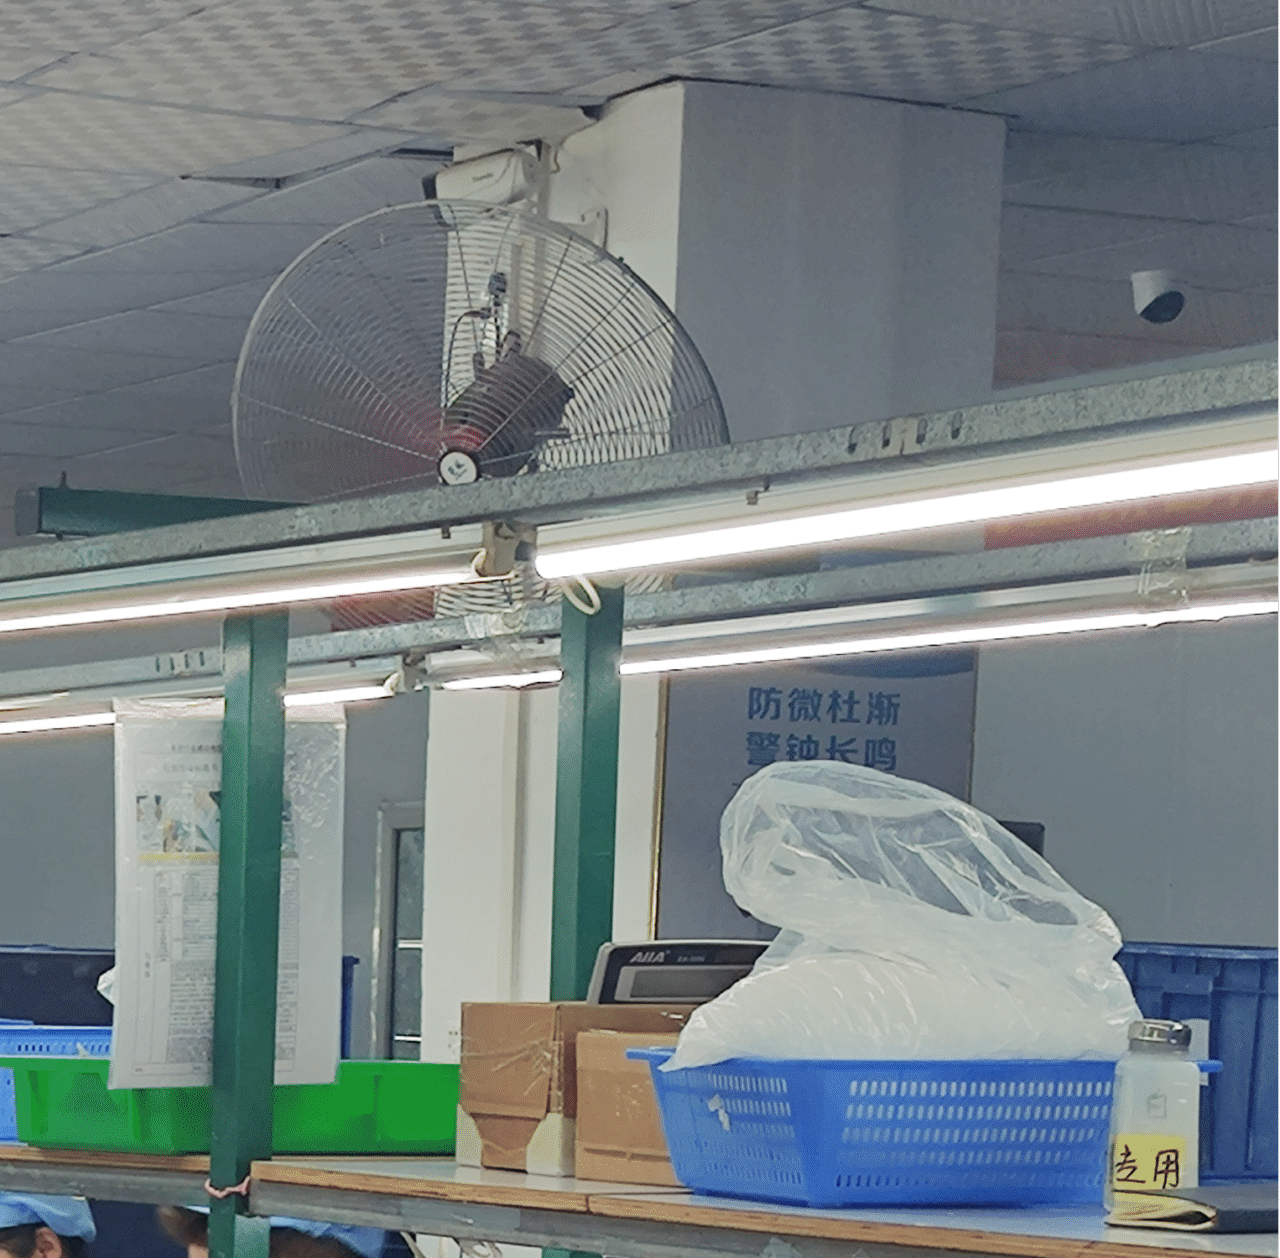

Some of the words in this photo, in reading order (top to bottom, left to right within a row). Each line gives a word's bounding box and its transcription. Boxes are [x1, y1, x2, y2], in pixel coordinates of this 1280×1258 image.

[747, 686, 901, 727] 防微杜渐
[746, 731, 897, 771] 警钟长鸣
